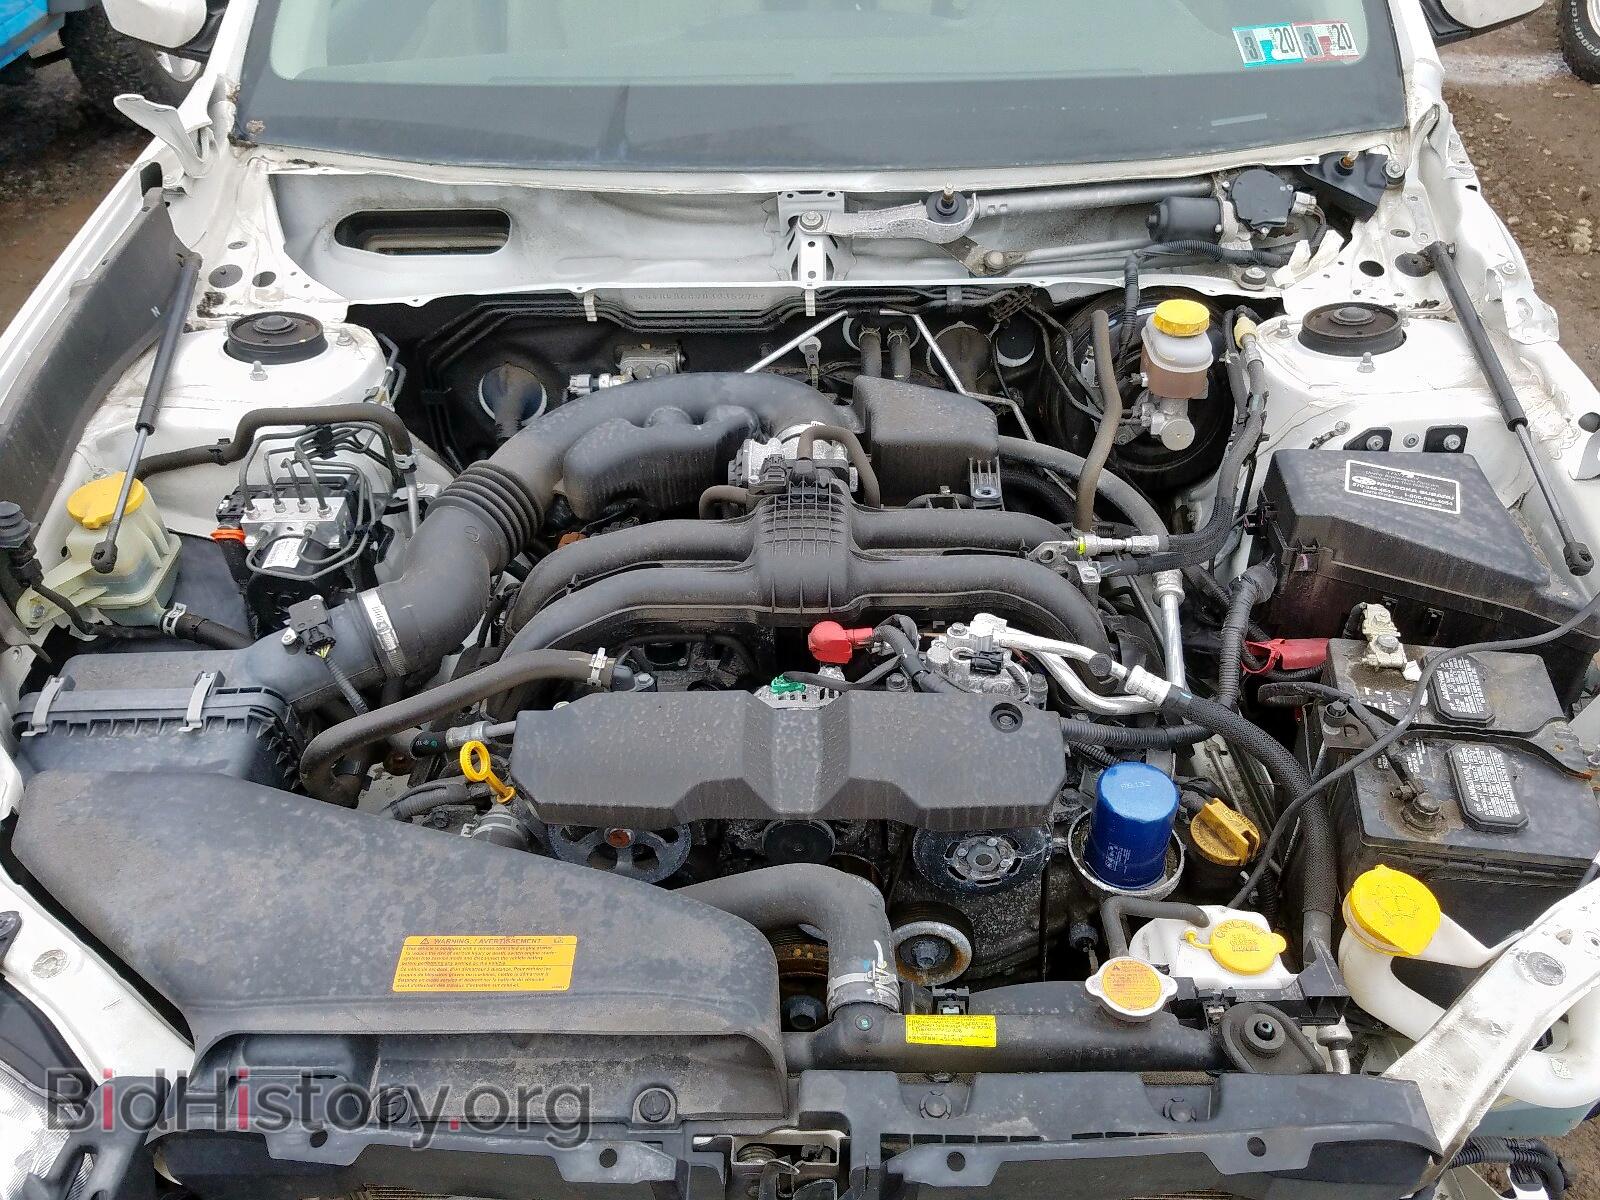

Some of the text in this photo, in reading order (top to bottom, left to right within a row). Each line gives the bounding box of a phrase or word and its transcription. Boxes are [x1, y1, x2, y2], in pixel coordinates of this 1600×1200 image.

[1244, 36, 1258, 60] 3
[1274, 27, 1296, 54] 20
[1303, 32, 1319, 56] 3
[1331, 23, 1353, 51] 20
[477, 937, 542, 945] AVERTISSEMENT
